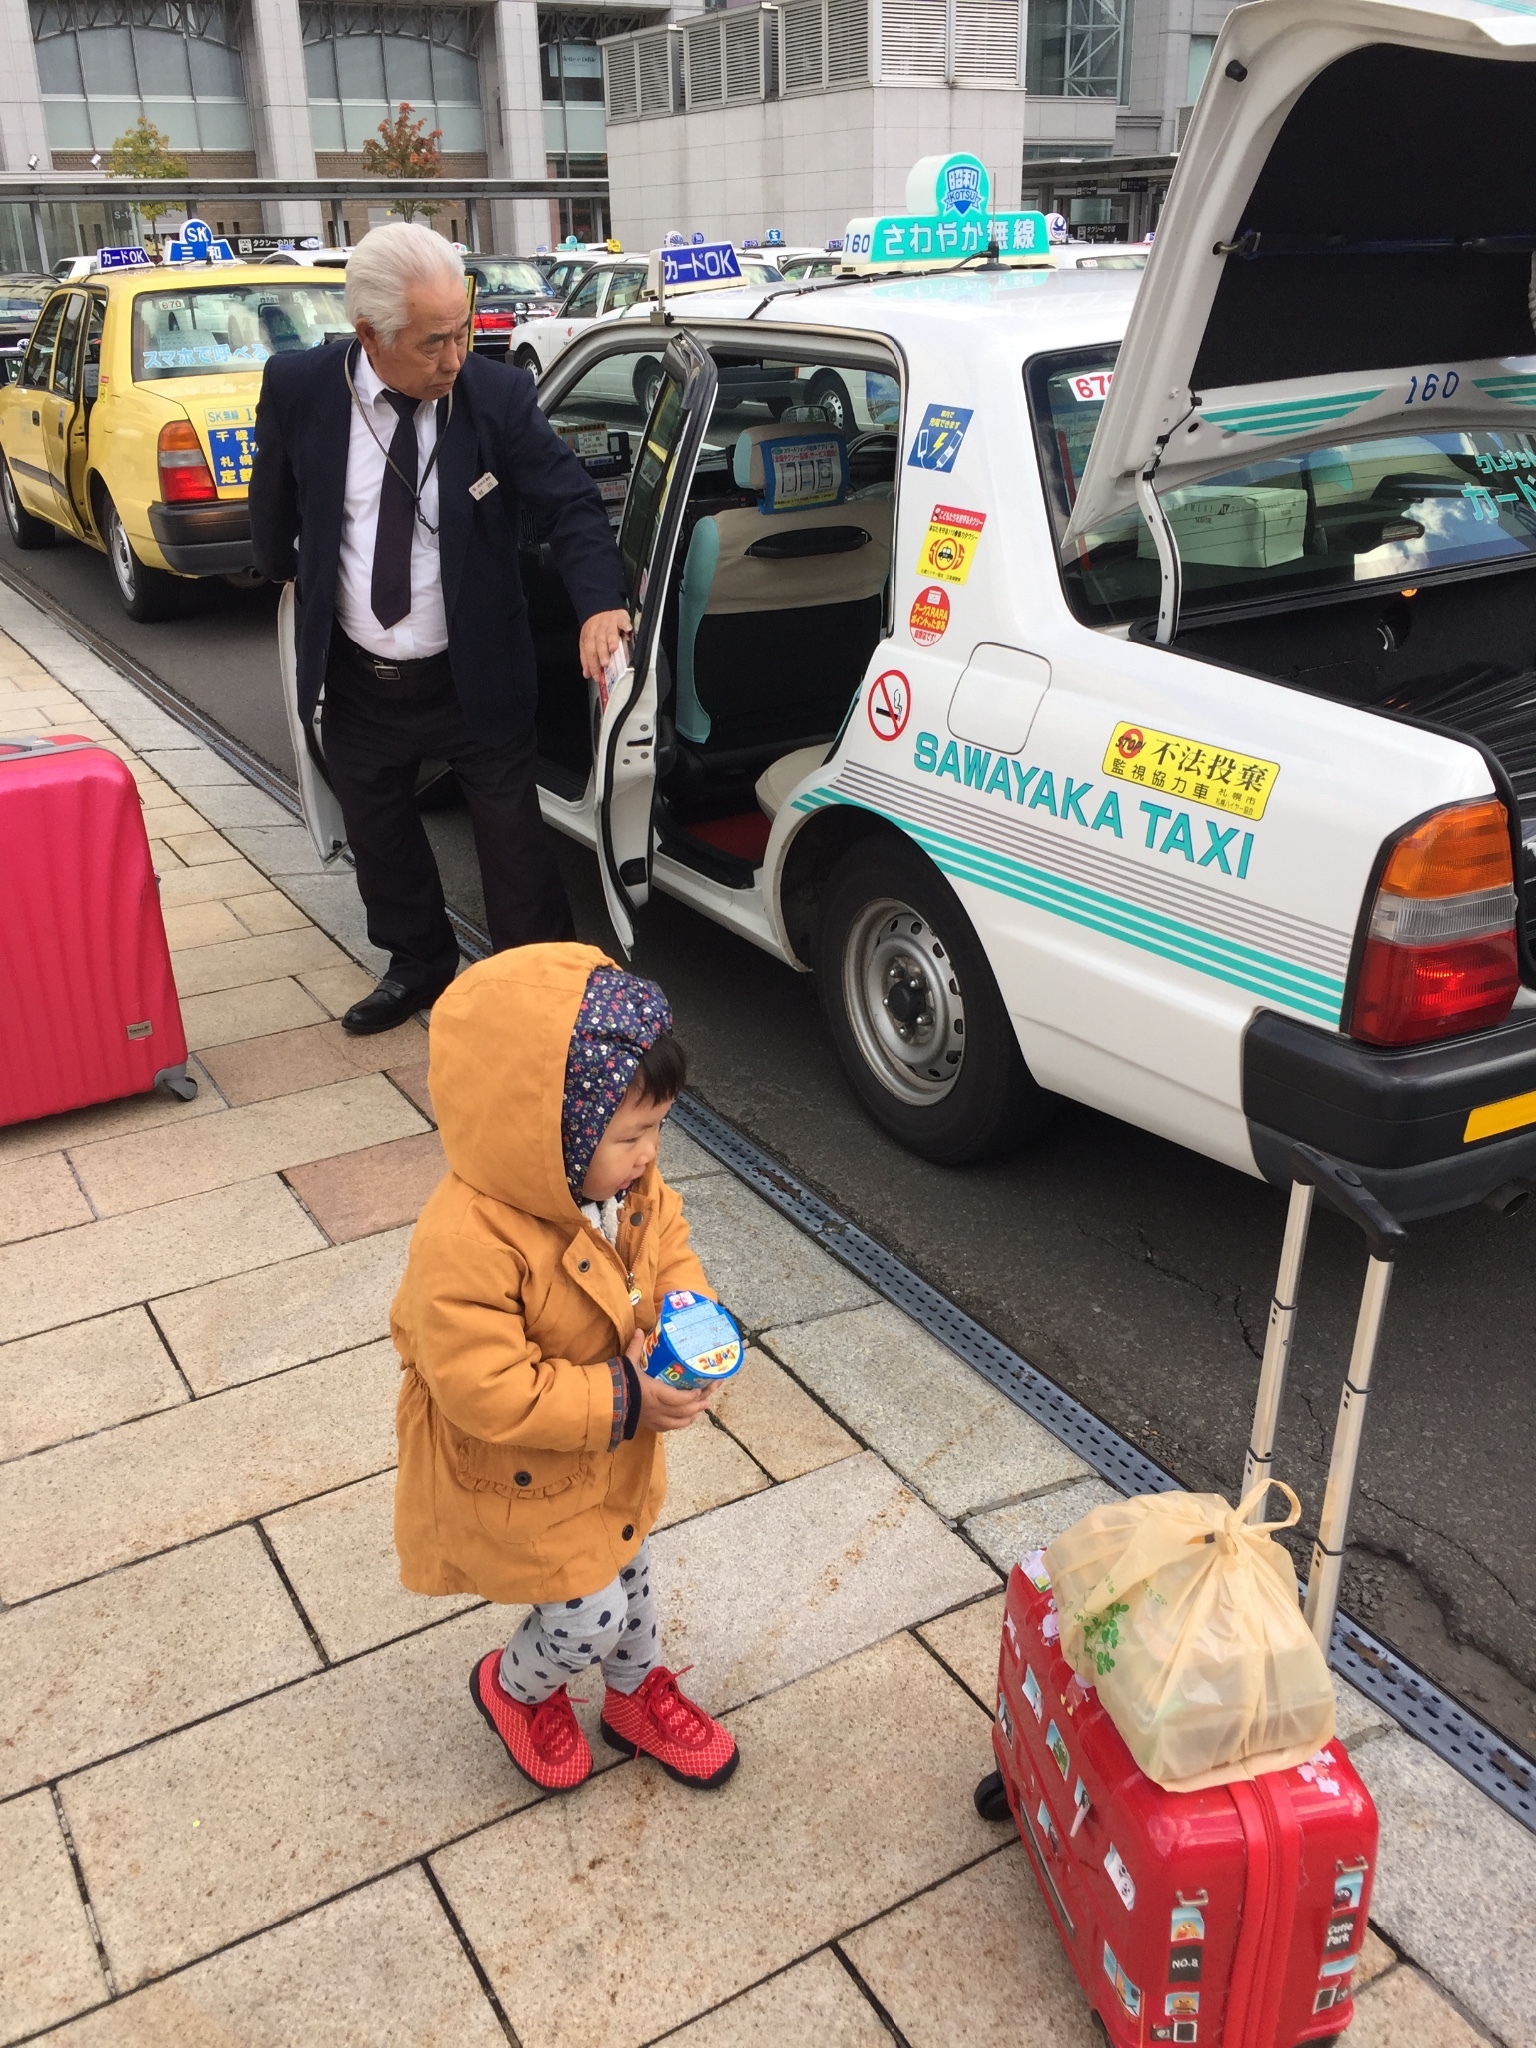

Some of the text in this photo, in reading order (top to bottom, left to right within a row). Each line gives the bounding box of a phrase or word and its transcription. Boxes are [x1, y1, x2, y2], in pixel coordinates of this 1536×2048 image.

[949, 168, 978, 191] 昭和
[950, 190, 976, 201] KOTSU
[186, 226, 209, 243] SK
[845, 234, 870, 254] 160
[883, 218, 1035, 256] さわやか無線
[102, 250, 145, 265] カードOK
[181, 246, 221, 261] 三和
[665, 249, 735, 281] カードOK
[143, 343, 270, 370] スマホで呼べる
[1405, 371, 1459, 404] 160
[1461, 474, 1536, 521] カード
[1150, 738, 1269, 793] 不法投棄
[1111, 758, 1209, 800] 監視協力車
[914, 731, 1255, 880] SAWAYAKA TAXI
[1219, 788, 1256, 806] 札幌市
[1172, 1958, 1199, 1969] NO.8
